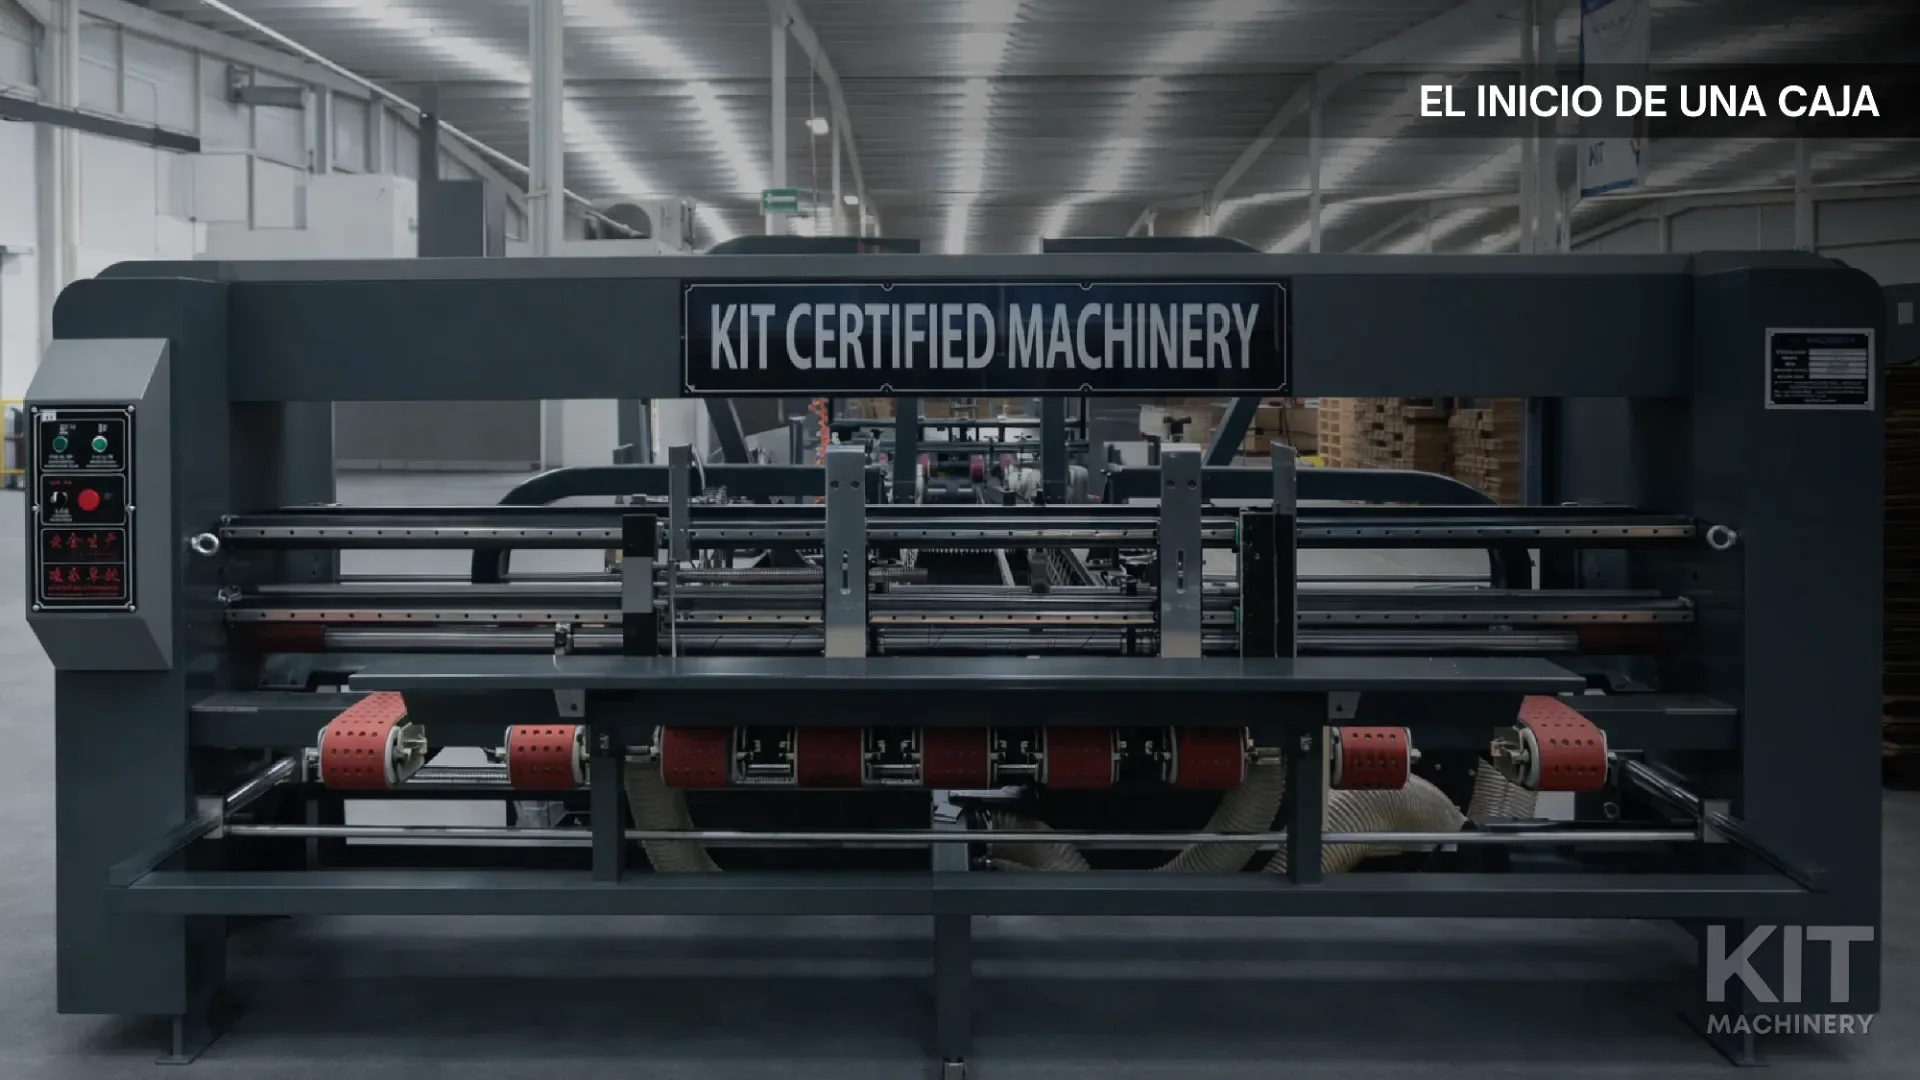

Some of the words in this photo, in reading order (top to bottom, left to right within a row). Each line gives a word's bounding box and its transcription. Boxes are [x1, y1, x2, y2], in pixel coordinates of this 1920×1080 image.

[711, 303, 776, 369] KIT
[786, 302, 996, 370] CERTIFIED
[1008, 302, 1260, 370] MACHINERY
